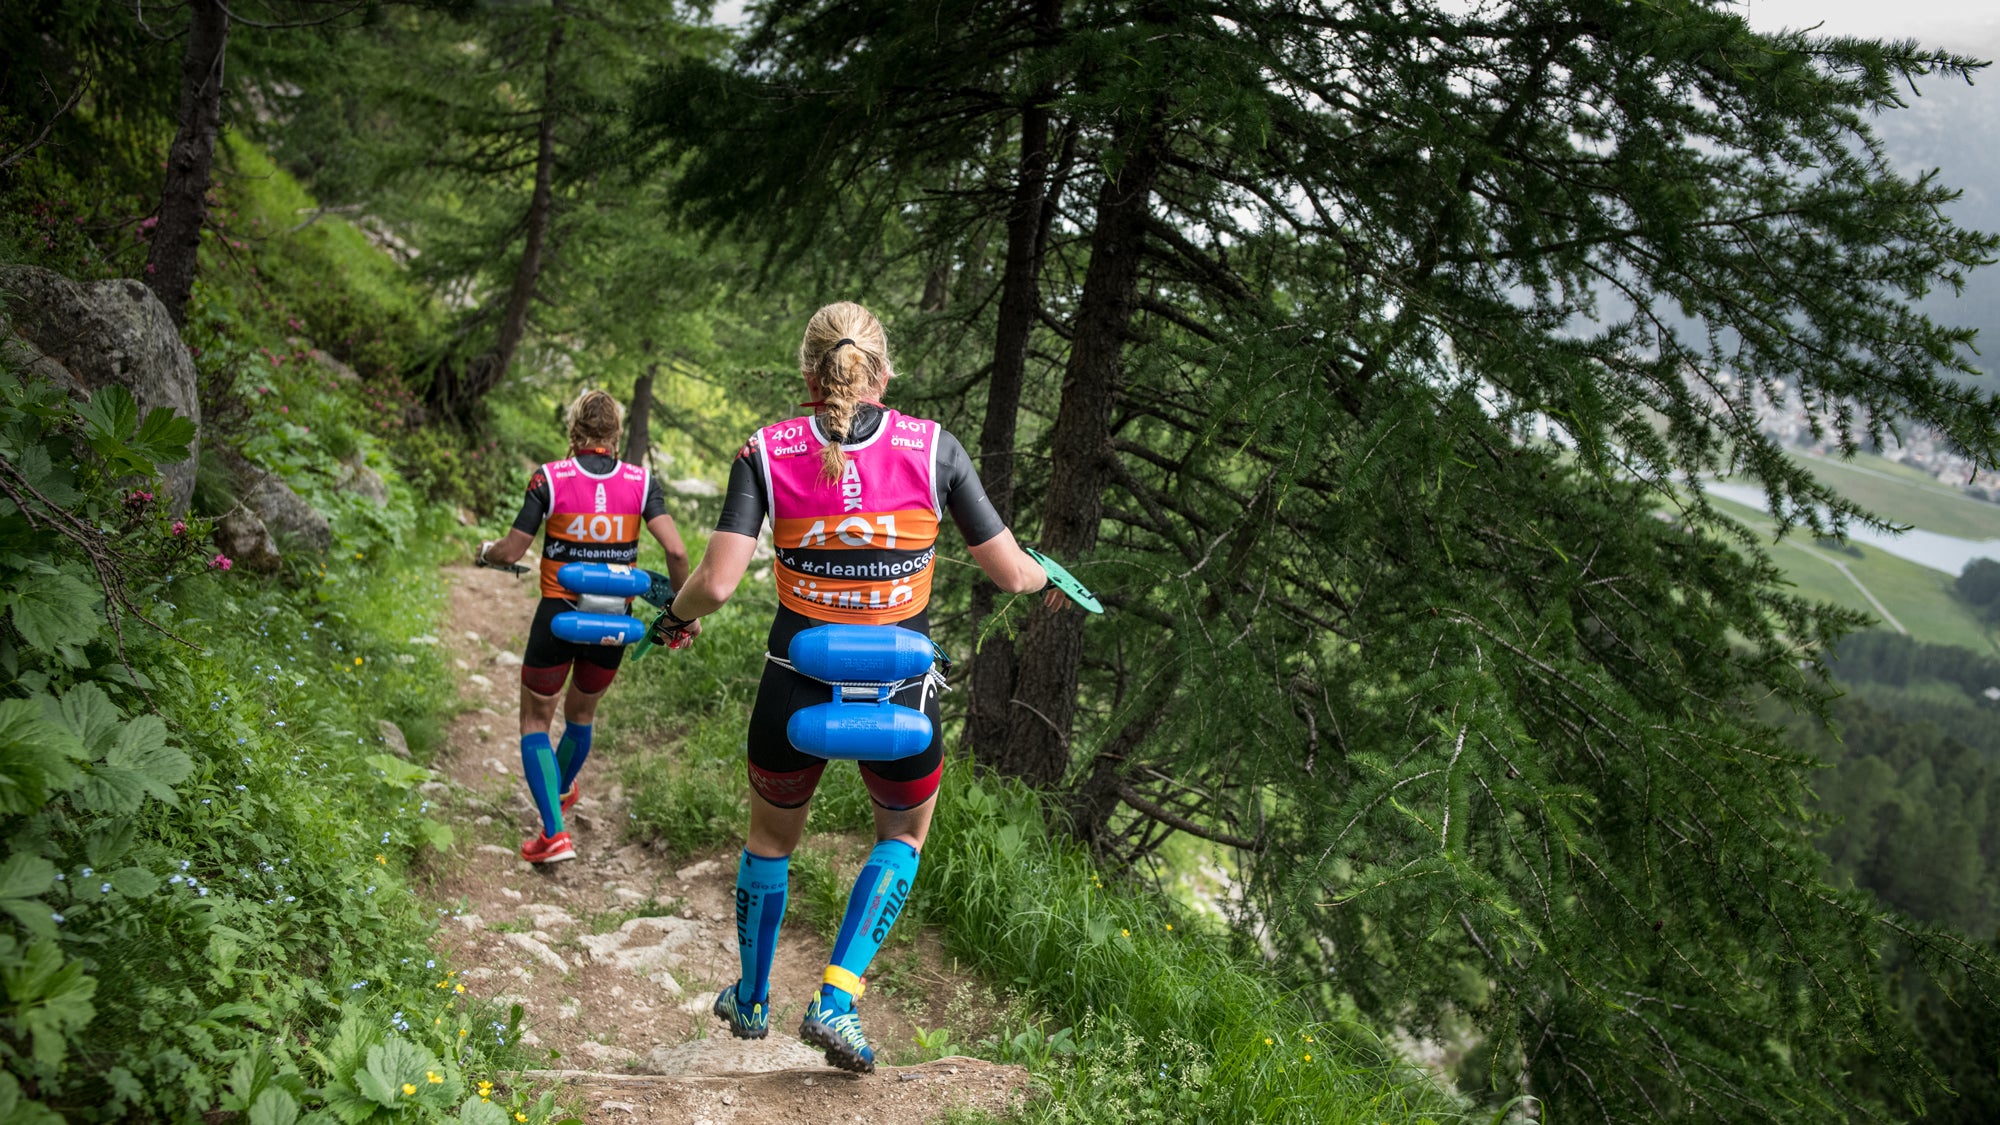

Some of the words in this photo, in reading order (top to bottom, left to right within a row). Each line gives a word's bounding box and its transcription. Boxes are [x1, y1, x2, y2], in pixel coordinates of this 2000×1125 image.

[771, 425, 803, 441] 401
[896, 420, 927, 434] 401
[774, 441, 808, 456] ÖTILLÖ
[842, 459, 862, 513] ARK
[566, 515, 624, 542] 401
